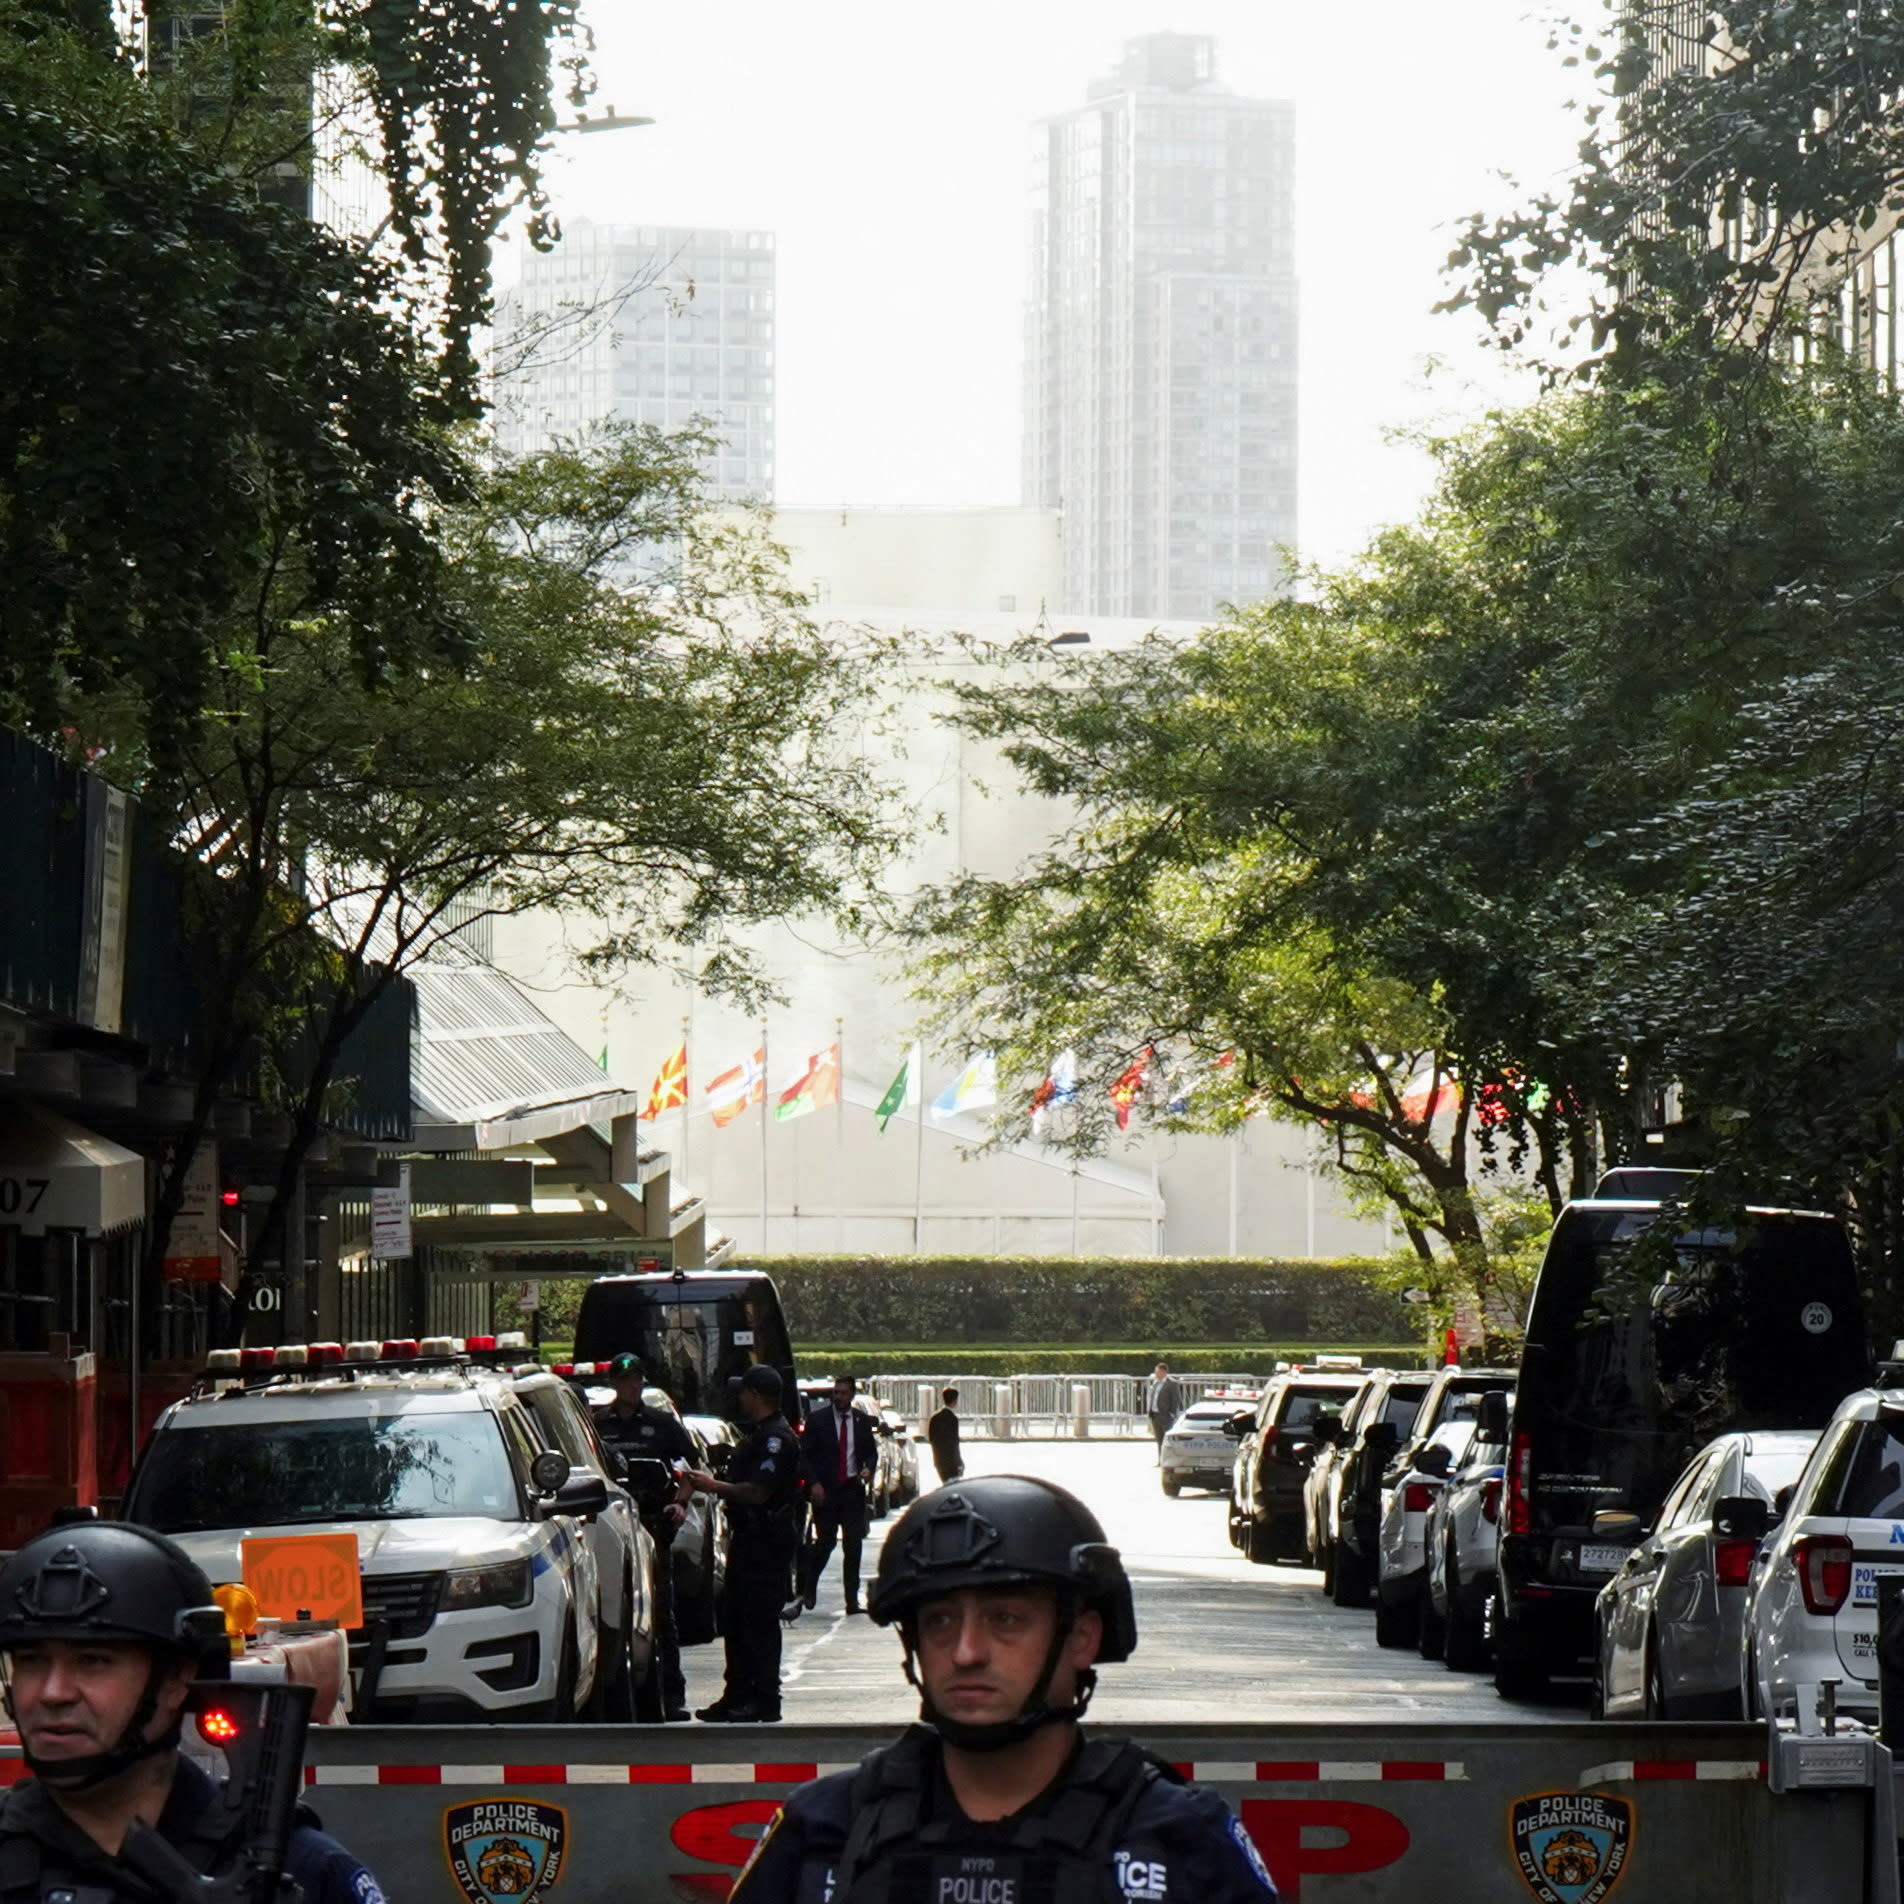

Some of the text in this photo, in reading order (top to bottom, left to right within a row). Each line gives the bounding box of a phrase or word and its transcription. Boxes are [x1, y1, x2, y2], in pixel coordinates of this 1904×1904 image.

[1809, 1313, 1825, 1326] 20
[472, 1803, 539, 1822] POLICE
[1538, 1796, 1605, 1814] POLICE
[451, 1817, 561, 1844] DEPARTMENT
[1516, 1810, 1627, 1837] DEPARTMENT
[538, 1850, 561, 1887] YORK
[960, 1857, 995, 1873] NYPD
[1603, 1841, 1627, 1878] YORK
[454, 1859, 478, 1892] CITY
[1518, 1850, 1559, 1904] CITY OF
